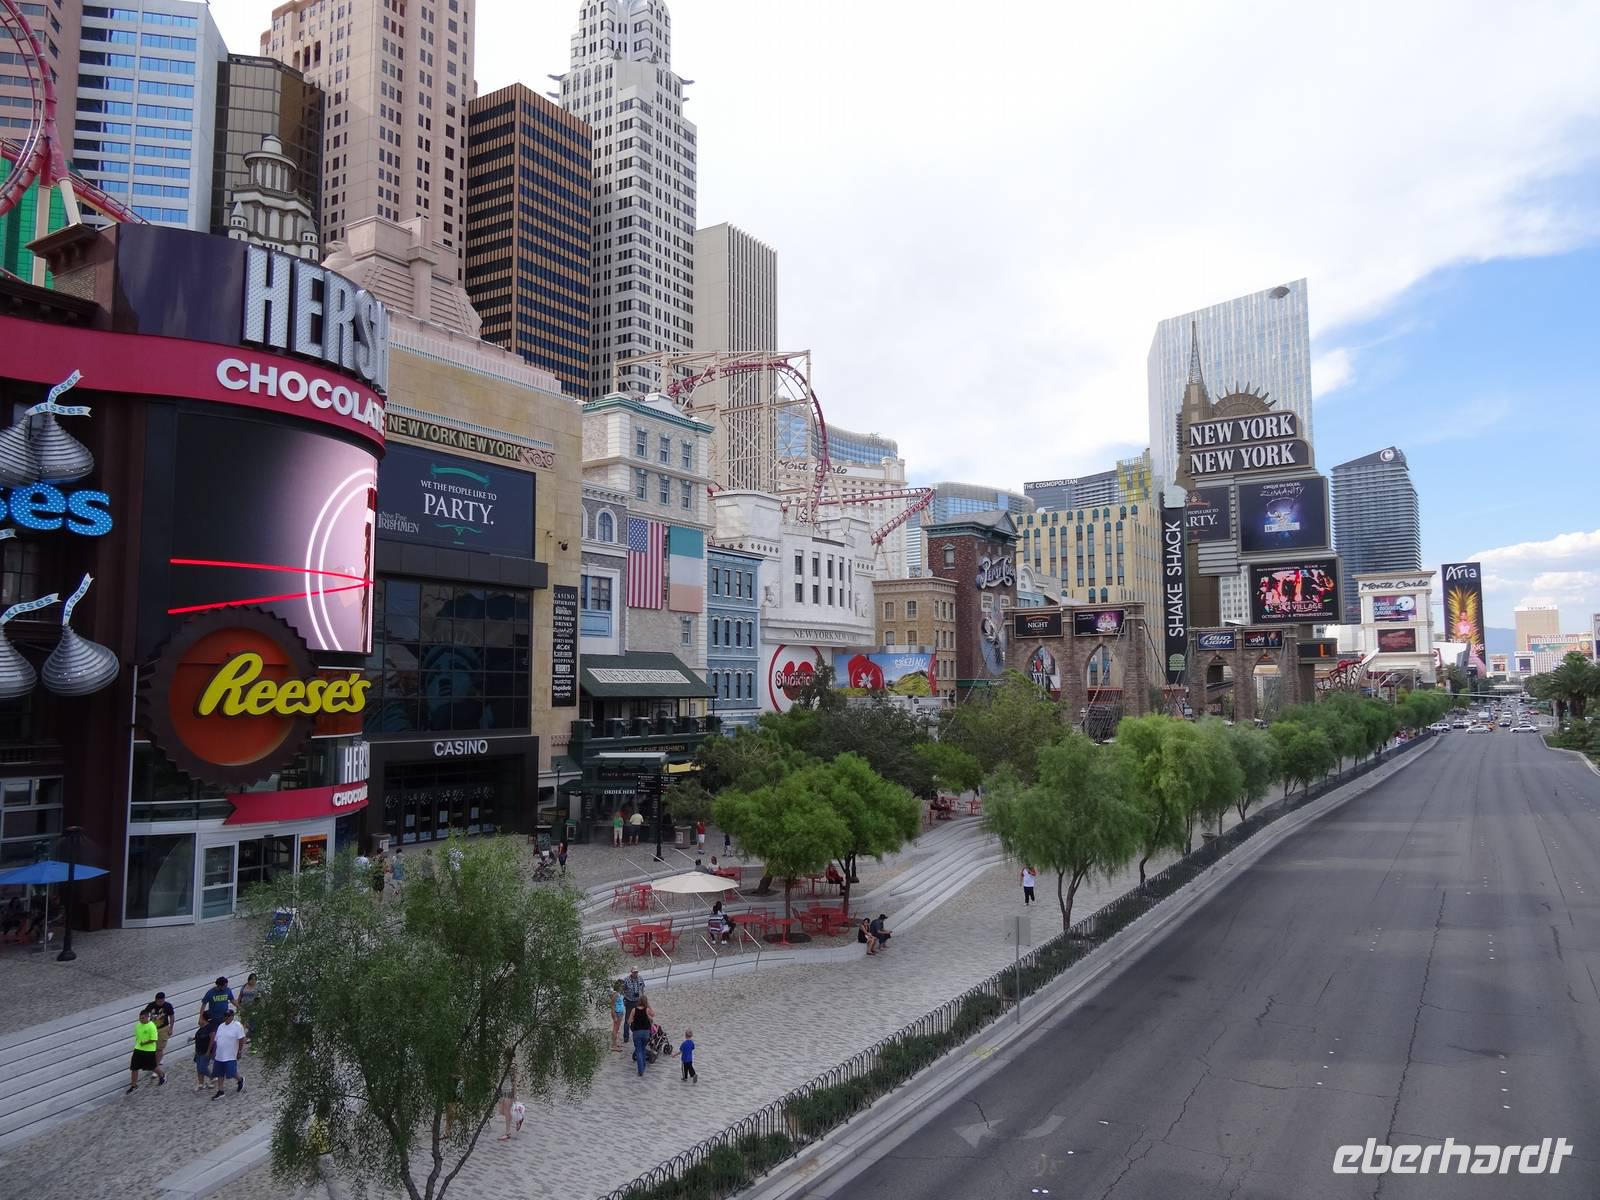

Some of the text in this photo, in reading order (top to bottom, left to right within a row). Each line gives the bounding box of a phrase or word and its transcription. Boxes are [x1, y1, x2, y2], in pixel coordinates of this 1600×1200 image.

[35, 404, 84, 414] kisses
[1190, 414, 1294, 446] NEW YORK
[779, 461, 848, 475] Mont Crlo
[1190, 442, 1296, 474] NEW YORK
[421, 480, 497, 501] WE THE PEOPLE LIKE TO
[1035, 479, 1078, 488] COSMOPOLITAN
[0, 482, 113, 536] es
[424, 493, 494, 525] PARTY.
[1165, 520, 1184, 637] SHAKE SHACK
[1446, 565, 1477, 581] Aria
[1361, 580, 1428, 590] Monte Carlo
[5, 595, 54, 620] kisses
[1027, 621, 1048, 629] NIGHT
[199, 652, 371, 716] Reese's
[434, 740, 488, 756] CASINO
